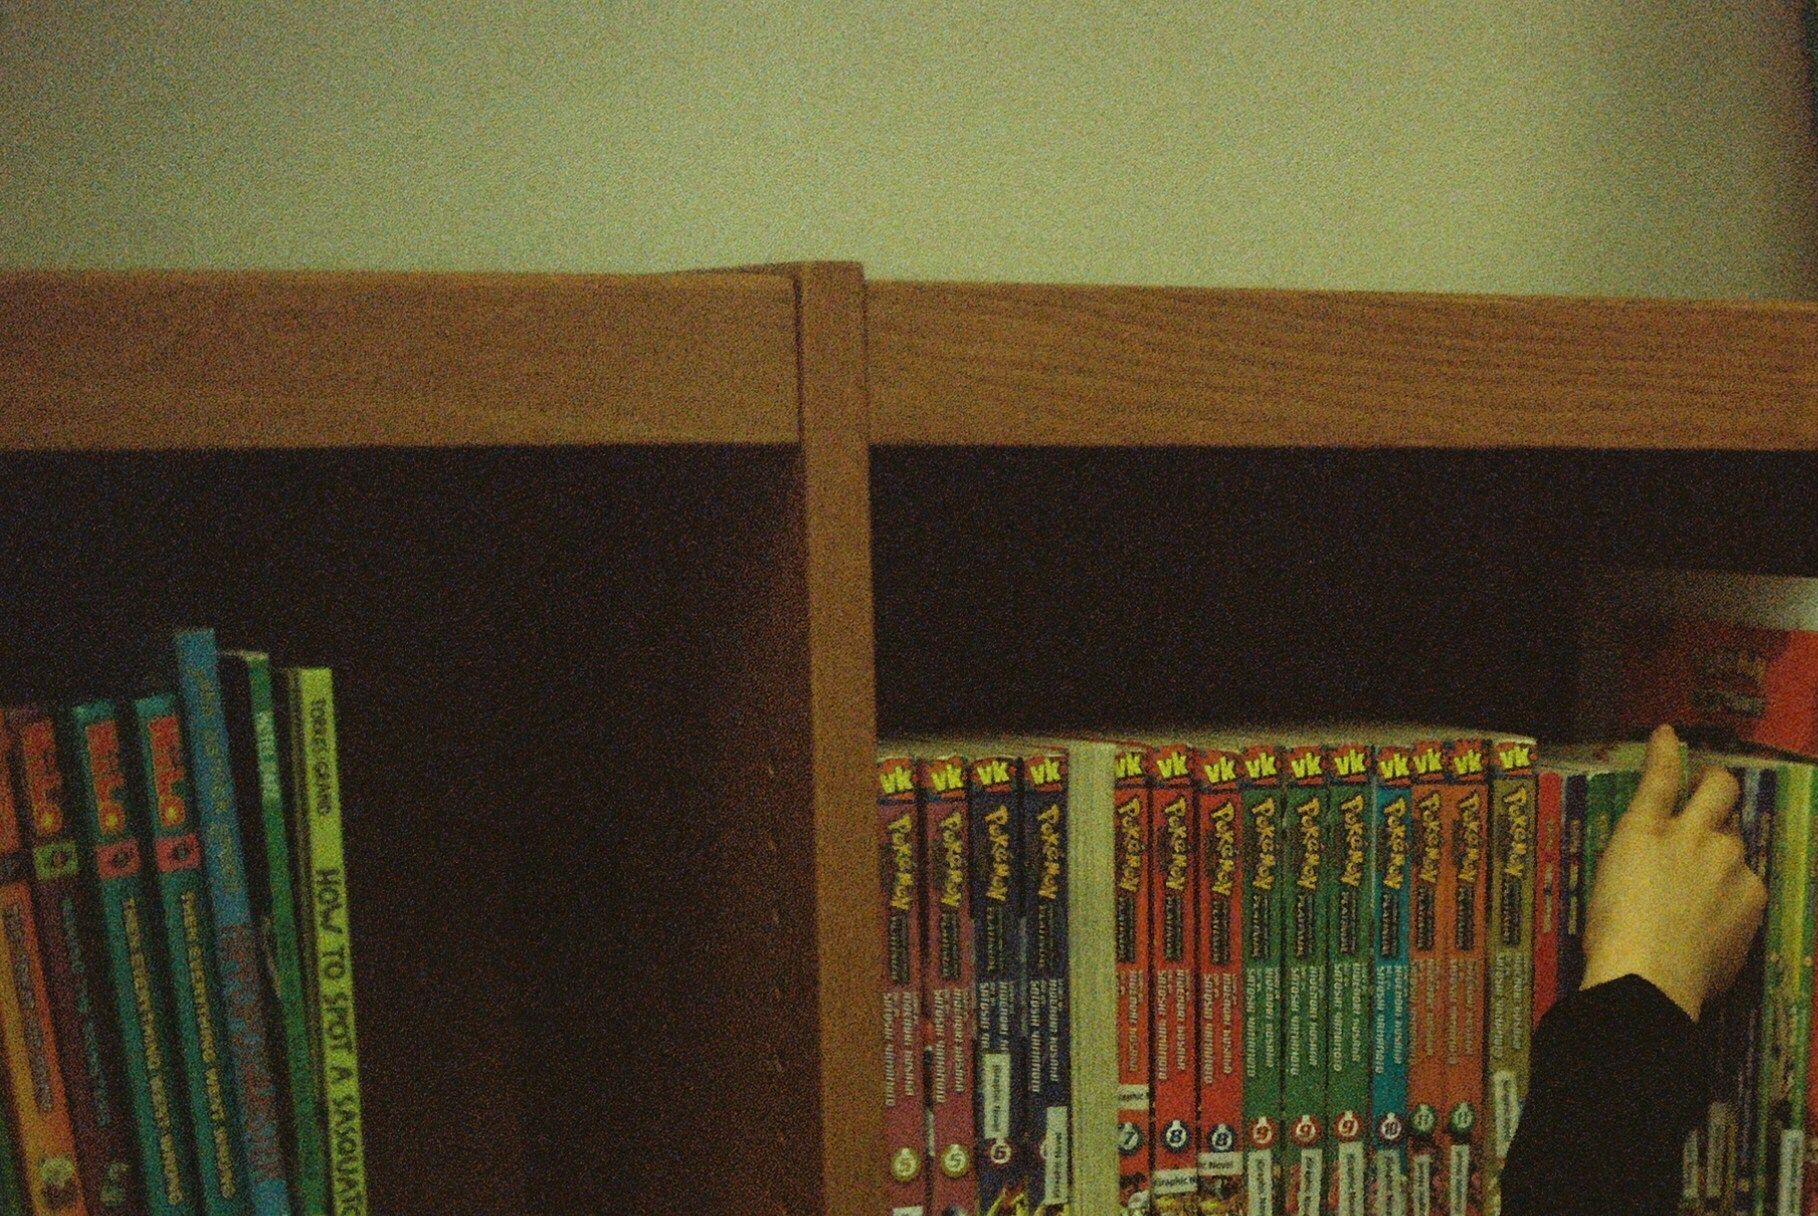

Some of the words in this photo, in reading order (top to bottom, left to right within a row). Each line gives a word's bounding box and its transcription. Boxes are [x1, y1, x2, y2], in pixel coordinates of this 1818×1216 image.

[315, 868, 344, 934] HOW
[322, 944, 346, 981] TO
[324, 991, 349, 1051] SPOT
[204, 1066, 226, 1120] WENT
[330, 1066, 350, 1087] A
